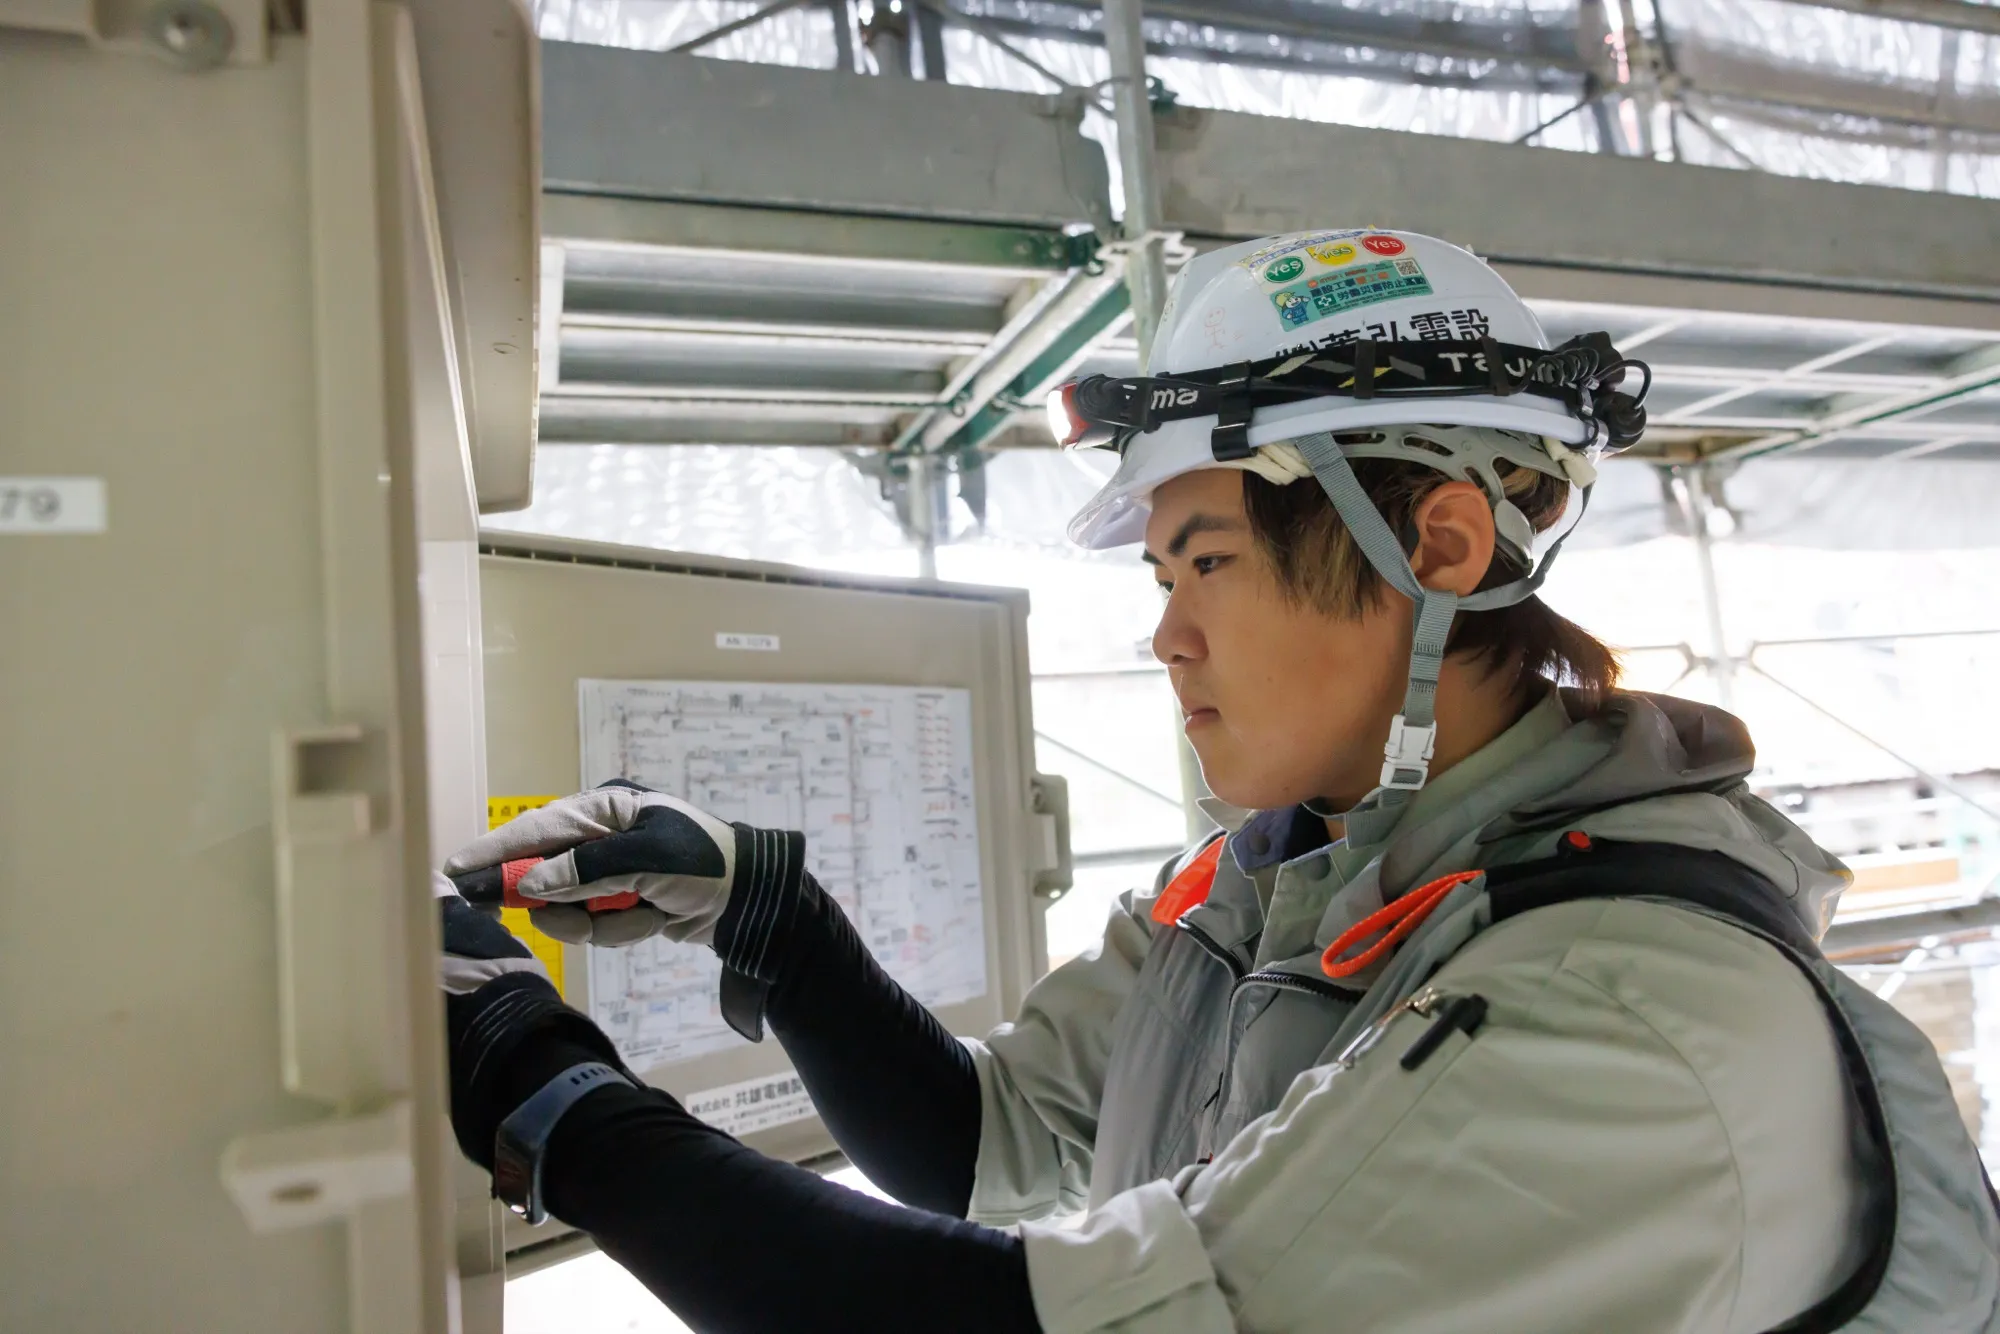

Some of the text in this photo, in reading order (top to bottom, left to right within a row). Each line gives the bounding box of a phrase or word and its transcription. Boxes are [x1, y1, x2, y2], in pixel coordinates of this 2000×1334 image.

[1368, 240, 1400, 249] Yes
[1266, 260, 1301, 276] Yes
[691, 1097, 731, 1115] 株式会社
